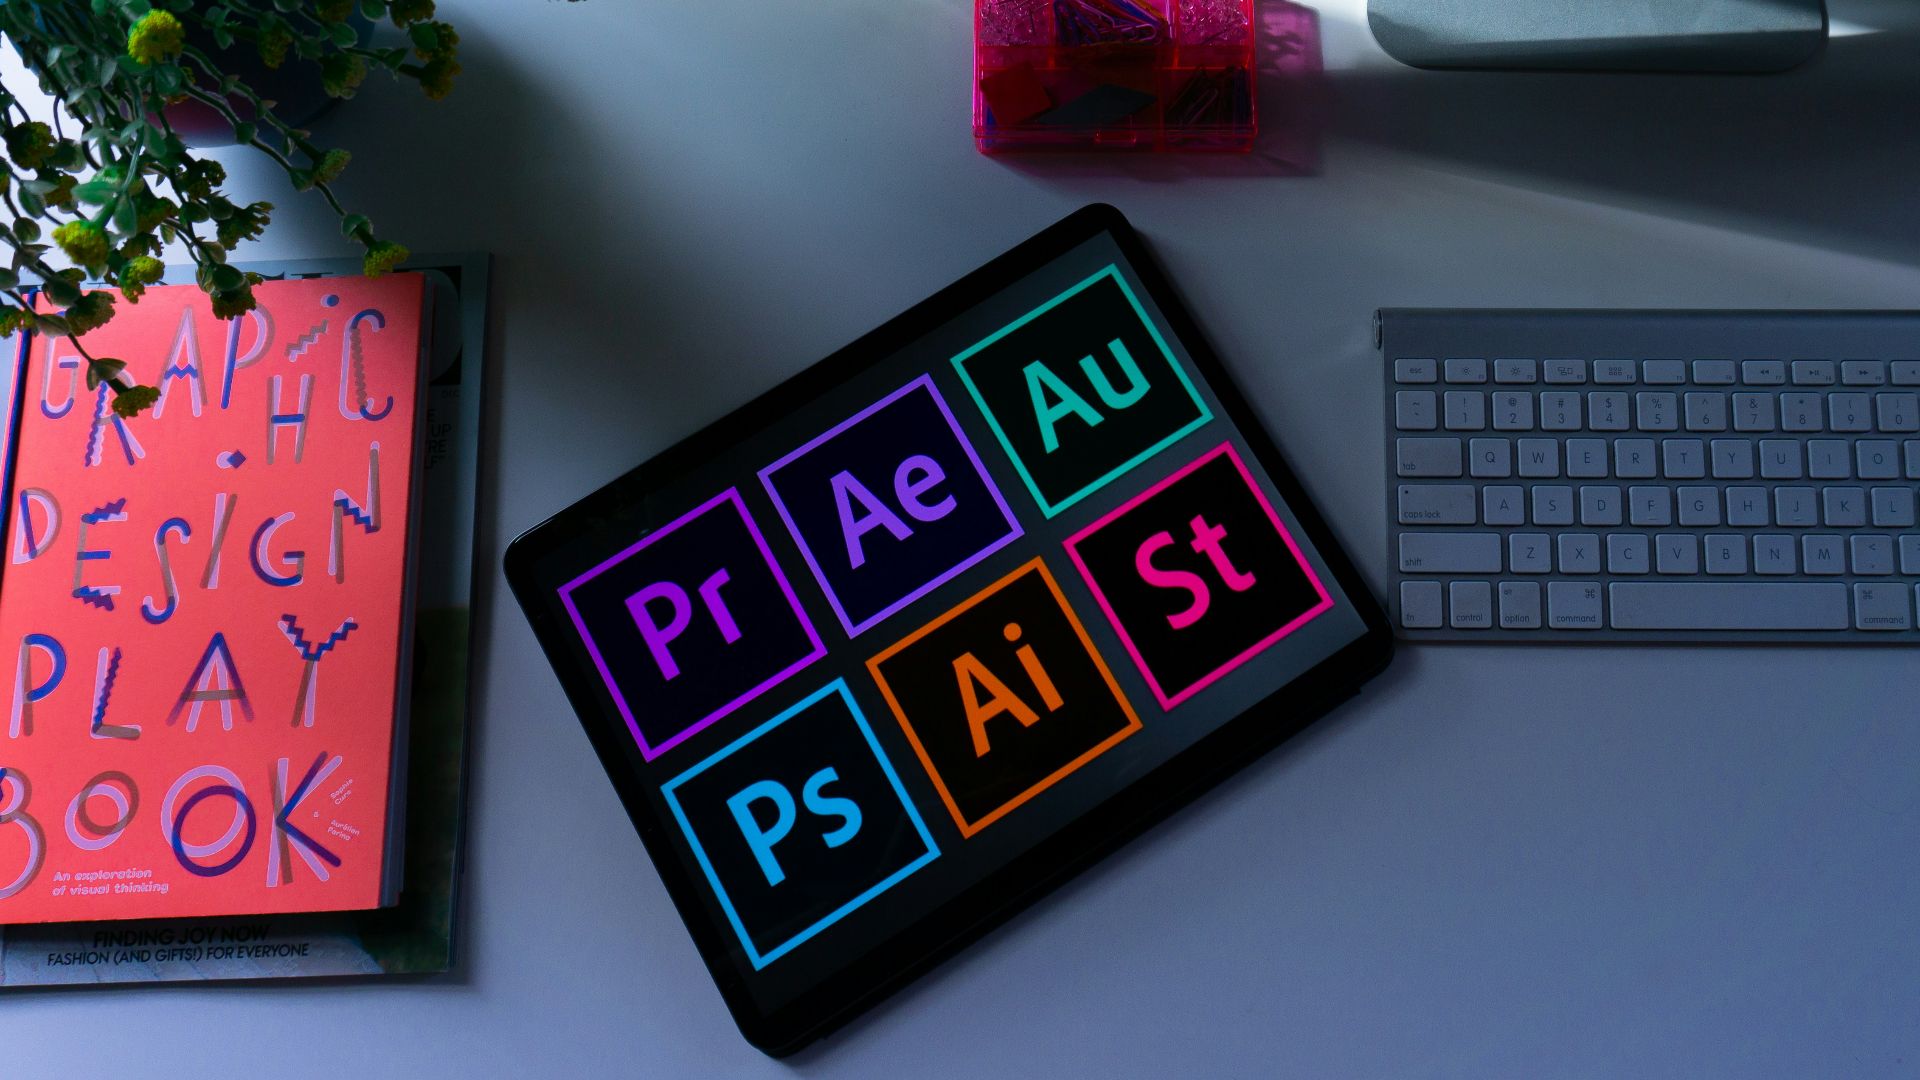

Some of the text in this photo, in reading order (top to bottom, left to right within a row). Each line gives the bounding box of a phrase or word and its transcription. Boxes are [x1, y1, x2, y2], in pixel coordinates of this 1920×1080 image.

[1409, 366, 1422, 375] esc
[41, 295, 394, 466] GRAPHIC
[1023, 339, 1150, 453] Au
[1508, 397, 1517, 407] @
[1558, 399, 1564, 408] #
[1605, 397, 1612, 408] $
[1651, 398, 1662, 409] %
[1750, 399, 1758, 409] &
[1510, 413, 1517, 424] 2
[1558, 413, 1565, 424] 3
[1606, 413, 1614, 424] 4
[1654, 413, 1662, 424] 5
[1702, 414, 1710, 424] 6
[1751, 414, 1757, 424] 7
[1799, 414, 1806, 425] 8
[1847, 414, 1854, 425] 9
[1895, 414, 1902, 425] 0
[1485, 452, 1496, 464] Q
[1532, 452, 1545, 464] W
[1584, 452, 1590, 464] E
[1632, 452, 1640, 464] R
[1680, 453, 1688, 464] T
[1728, 453, 1736, 464] Y
[1776, 453, 1786, 465] U
[1873, 453, 1883, 465] O
[1402, 462, 1416, 471] tab
[1499, 499, 1509, 511] A
[1549, 500, 1556, 511] S
[1597, 500, 1606, 511] D
[1648, 501, 1655, 512] F
[1694, 500, 1704, 512] G
[1744, 501, 1752, 512] H
[1793, 501, 1800, 513] J
[1841, 501, 1849, 513] K
[1890, 501, 1896, 513] L
[830, 454, 957, 569] Ae
[1403, 510, 1441, 520] caps lock
[13, 441, 382, 625] DESIGN
[1526, 547, 1535, 559] Z
[1575, 548, 1584, 560] X
[1623, 548, 1632, 560] C
[1672, 548, 1682, 560] V
[1723, 548, 1730, 560] B
[1770, 548, 1780, 560] N
[1818, 548, 1831, 561] M
[1405, 557, 1422, 566] shift
[1136, 515, 1256, 629] St
[1407, 614, 1415, 622] fn
[1456, 613, 1483, 622] control
[1504, 613, 1530, 624] option
[1556, 613, 1596, 623] command
[1864, 615, 1904, 625] command
[625, 568, 742, 680] Pr
[8, 613, 359, 741] PLAY
[952, 623, 1064, 757] Ai
[329, 778, 354, 800] Sophie
[0, 750, 343, 899] BOOK
[726, 767, 862, 886] Ps
[53, 867, 152, 883] An exploration
[52, 881, 169, 897] of visual thinking
[93, 924, 270, 948] FINDING JOY NOW
[47, 943, 309, 966] FASHION (AND GIFTS!) FOR EVERYONE
